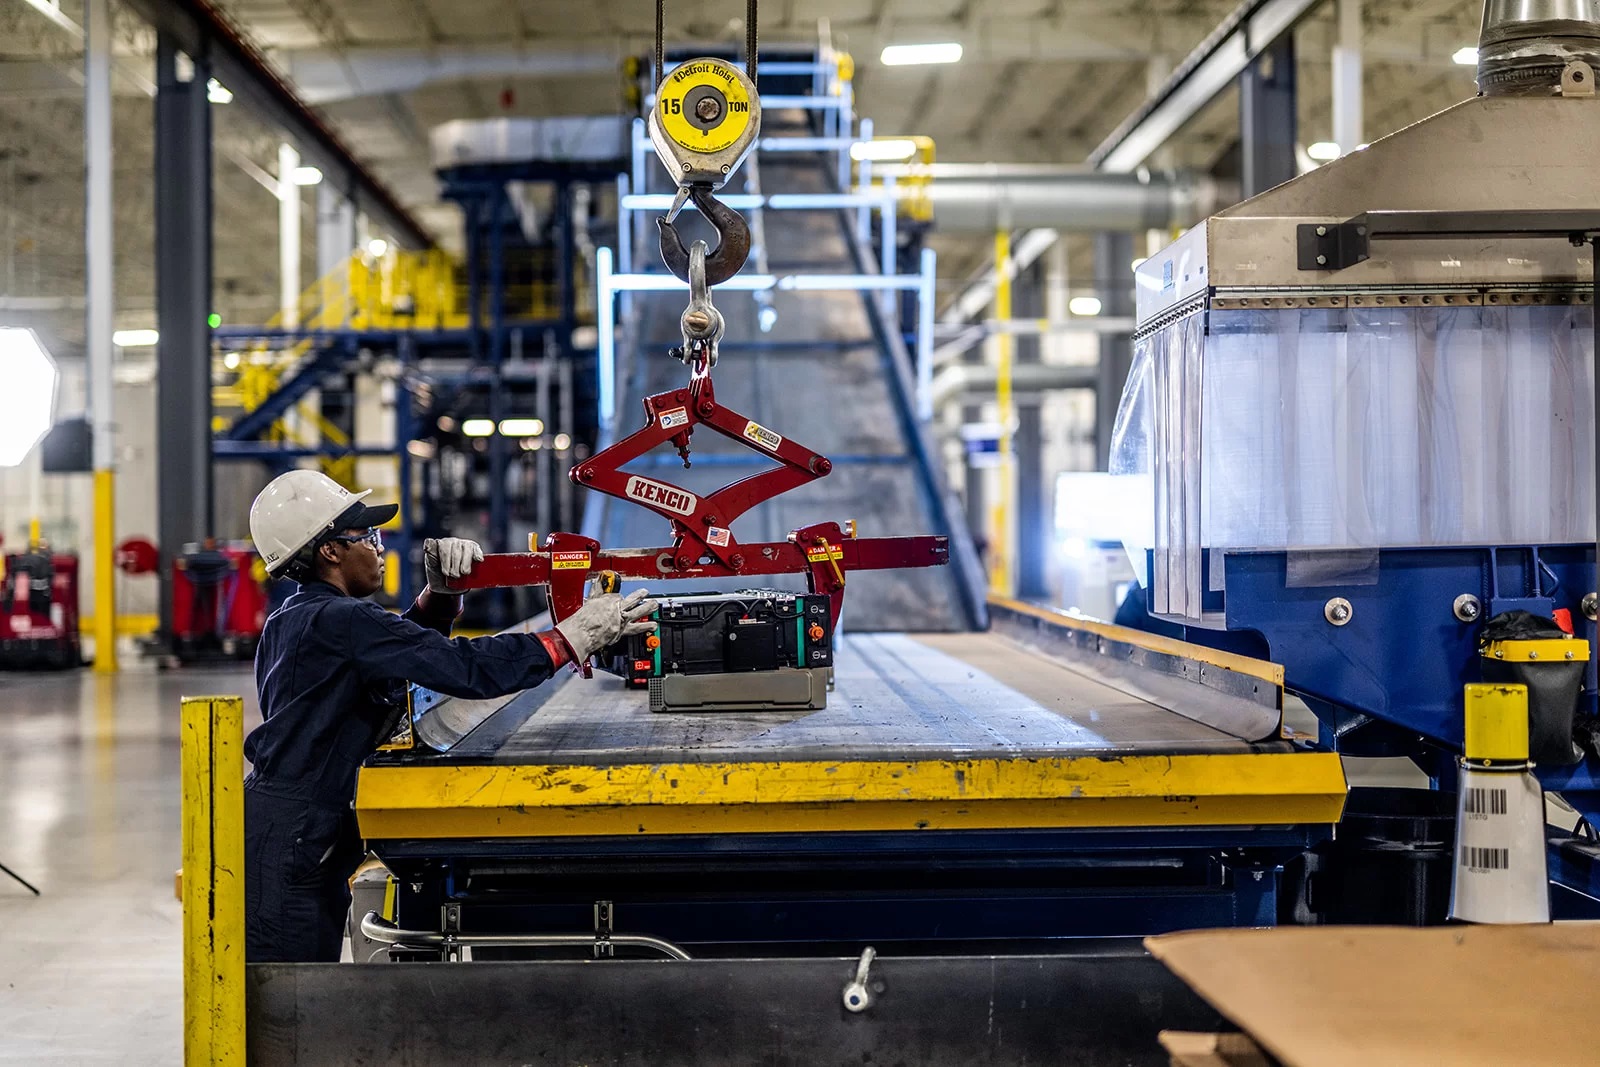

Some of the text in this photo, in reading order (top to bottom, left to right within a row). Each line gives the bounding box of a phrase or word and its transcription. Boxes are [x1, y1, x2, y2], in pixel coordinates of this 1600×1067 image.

[678, 64, 735, 84] Detroit Hoist
[662, 98, 748, 115] 15 TON
[757, 428, 778, 444] KENCO
[632, 480, 690, 511] KENCO
[813, 545, 837, 554] DANER
